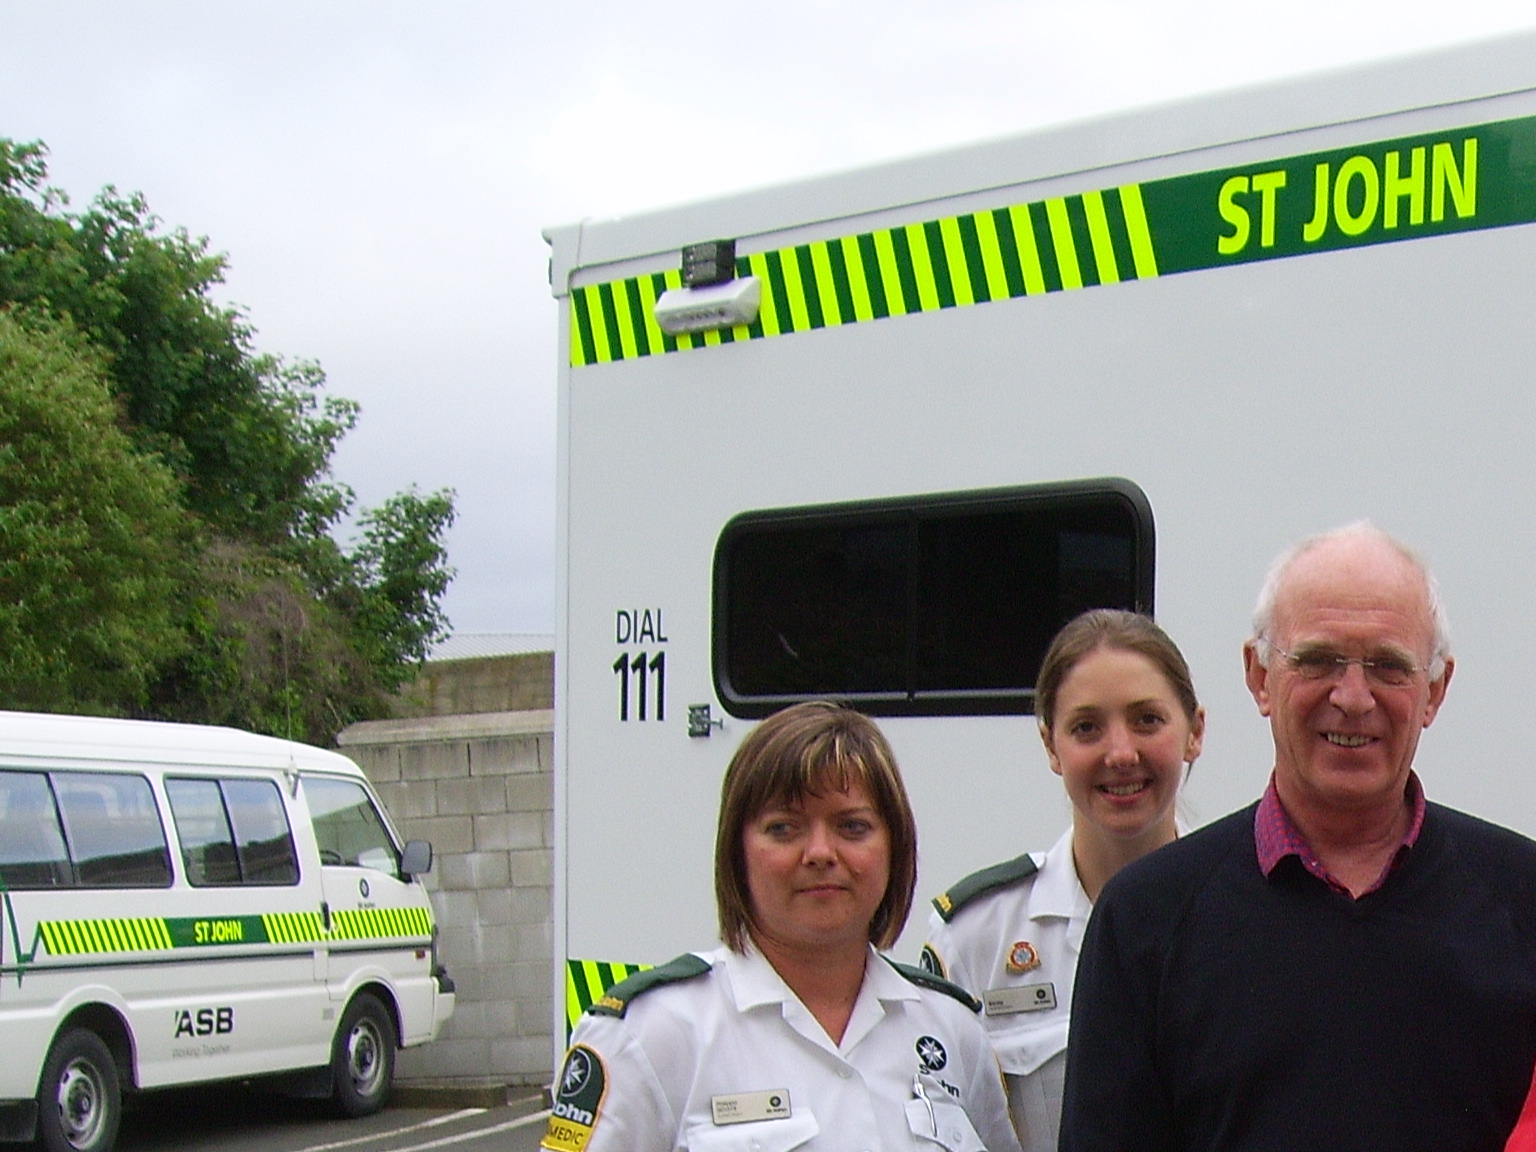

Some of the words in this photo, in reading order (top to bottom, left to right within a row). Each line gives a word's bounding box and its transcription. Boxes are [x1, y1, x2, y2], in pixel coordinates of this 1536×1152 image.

[1217, 170, 1287, 255] ST
[1303, 138, 1478, 243] JOHN
[616, 608, 668, 644] DIAL
[612, 650, 666, 722] 111
[194, 921, 210, 944] ST
[211, 920, 242, 942] JOHN
[175, 1006, 234, 1038] ASB
[919, 1064, 930, 1075] S
[552, 1103, 594, 1125] ohn
[548, 1126, 584, 1145] MEDIC
